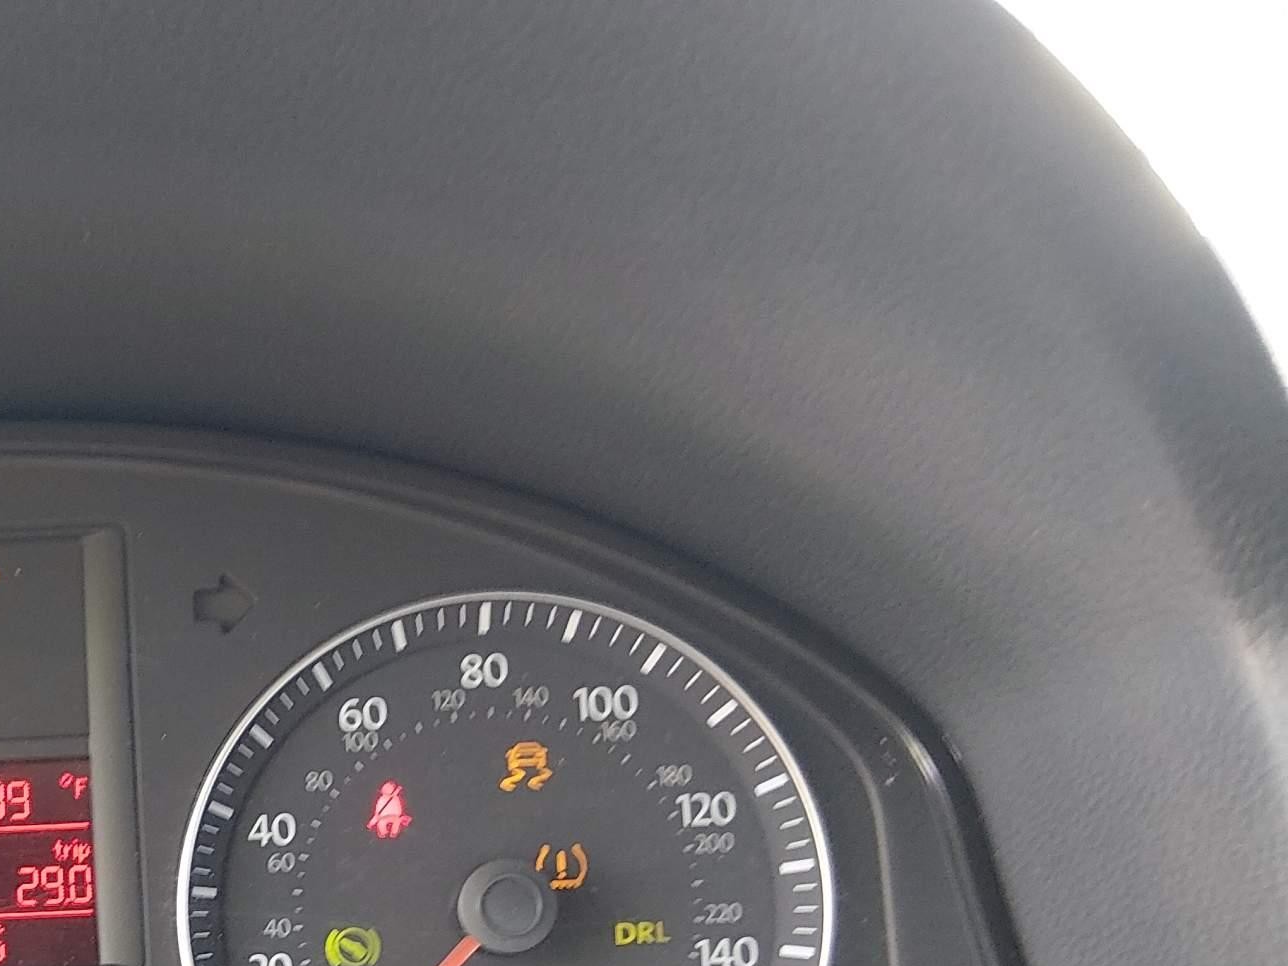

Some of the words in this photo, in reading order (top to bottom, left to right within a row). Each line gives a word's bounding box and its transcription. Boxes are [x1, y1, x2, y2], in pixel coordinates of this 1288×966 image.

[460, 652, 509, 689] 80
[431, 688, 466, 712] 120
[512, 686, 550, 708] 140
[572, 684, 638, 722] 100
[338, 696, 388, 732] 60
[342, 730, 379, 752] 100
[601, 719, 637, 742] 160
[304, 769, 333, 792] 80
[656, 764, 693, 787] 180
[675, 791, 737, 828] 120
[247, 812, 296, 847] 40
[53, 839, 91, 863] trip
[694, 832, 735, 854] 200
[267, 852, 295, 873] 60
[704, 902, 743, 925] 220
[263, 918, 292, 939] 40
[614, 921, 672, 946] DRL
